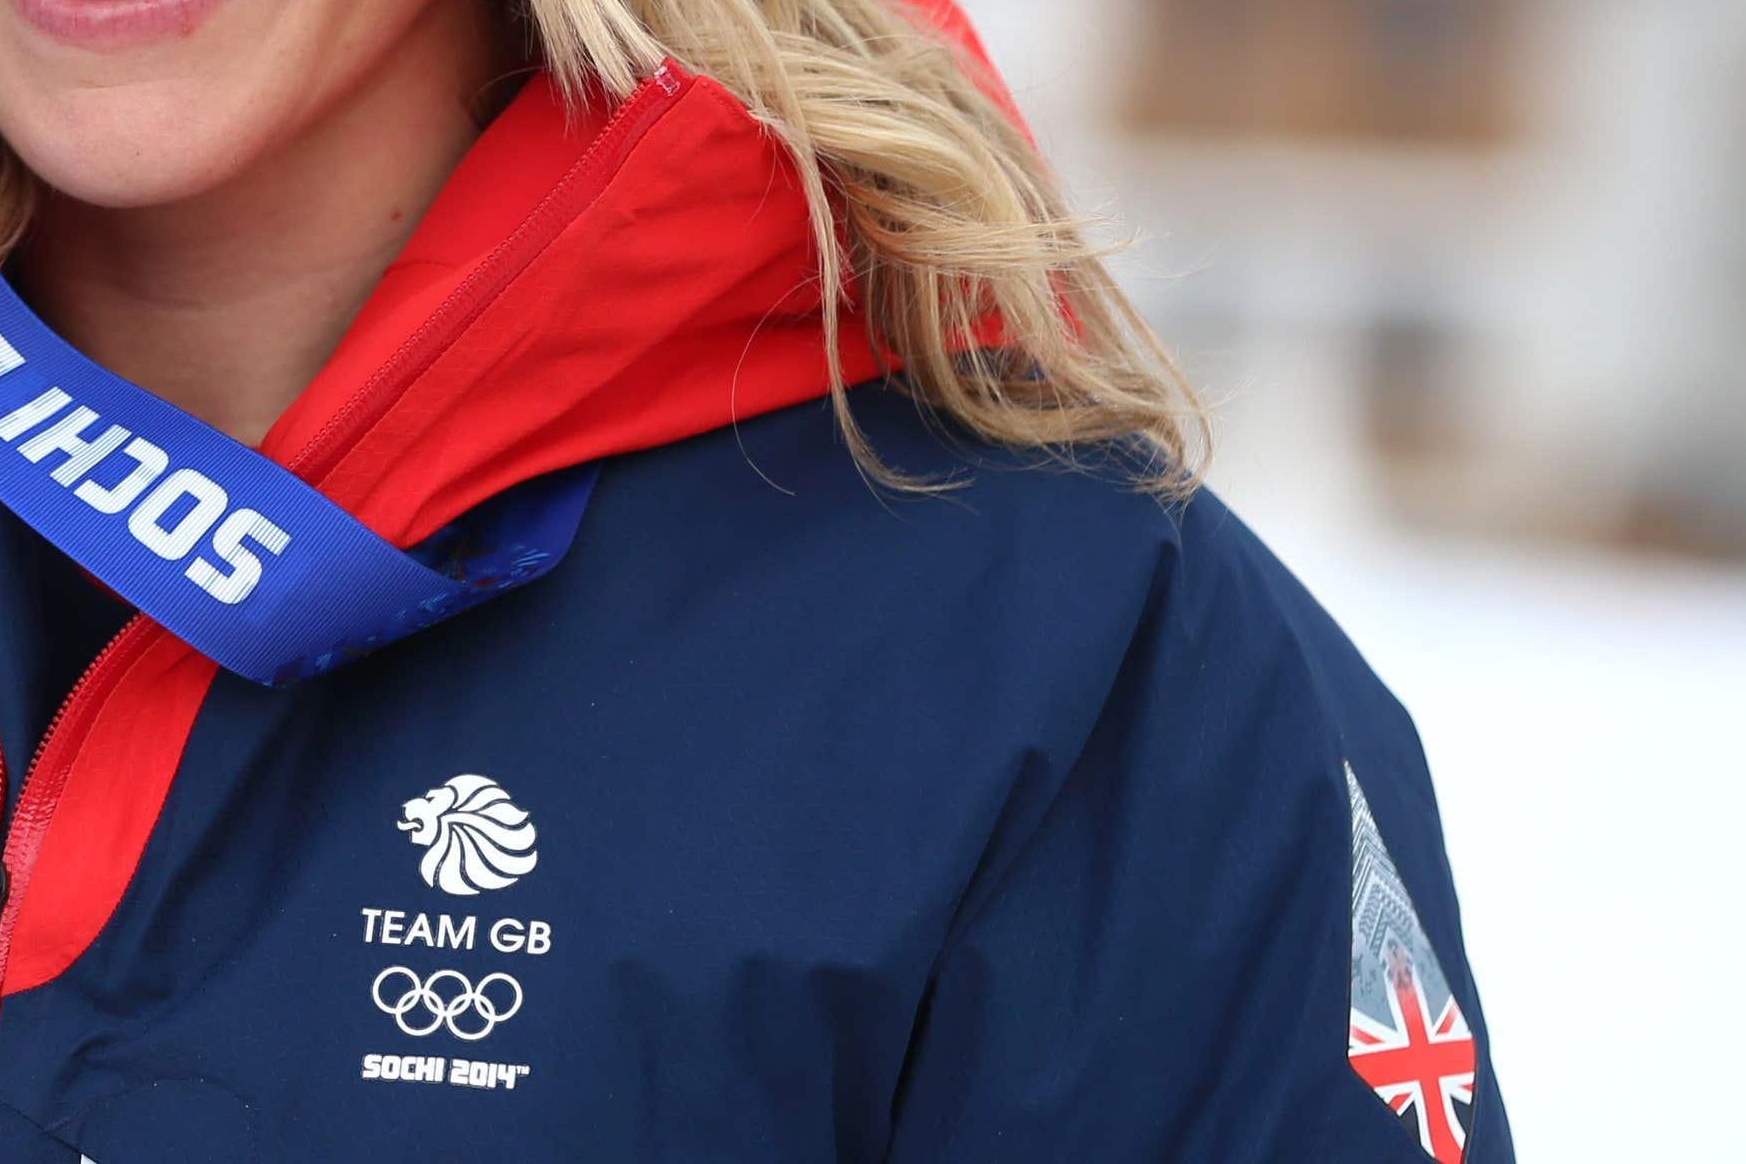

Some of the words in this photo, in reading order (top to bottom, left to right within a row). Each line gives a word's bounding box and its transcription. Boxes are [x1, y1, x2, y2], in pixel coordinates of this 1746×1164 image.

[361, 907, 477, 950] TEAM
[489, 916, 552, 955] GB
[362, 1053, 446, 1083] SOCHI
